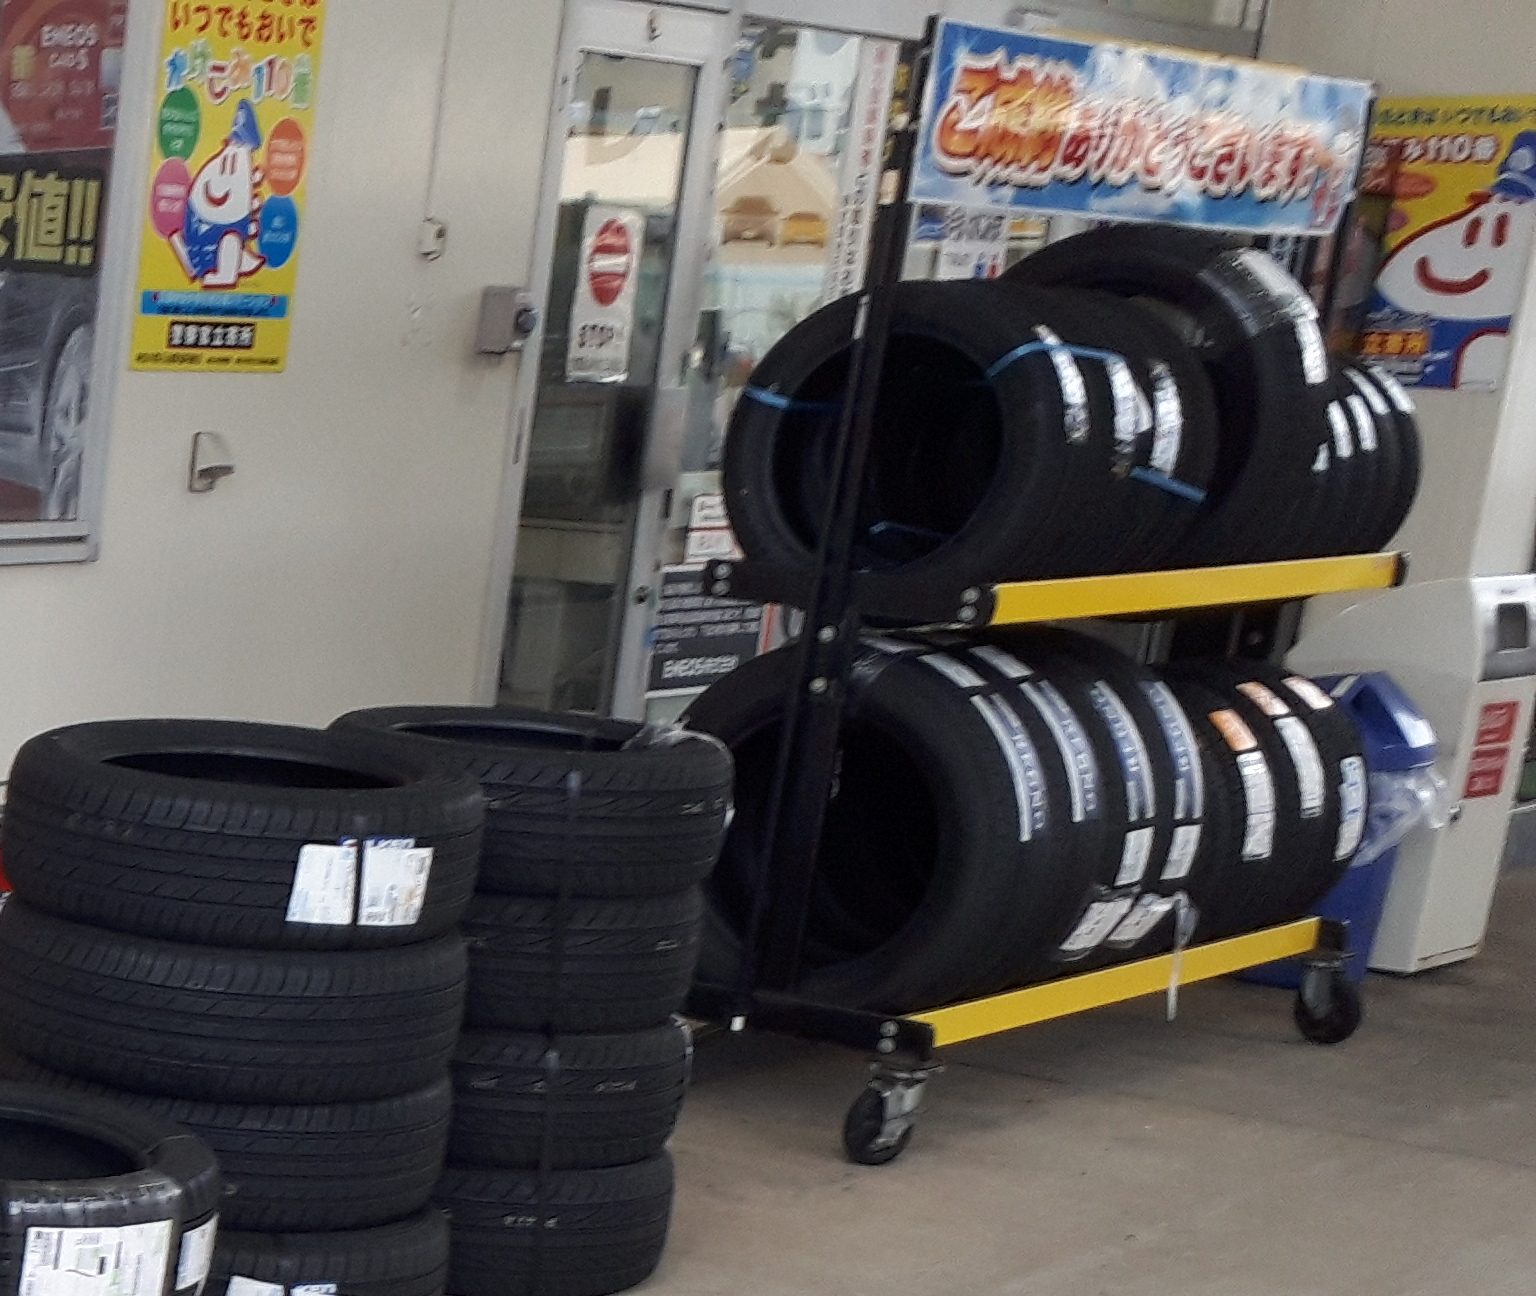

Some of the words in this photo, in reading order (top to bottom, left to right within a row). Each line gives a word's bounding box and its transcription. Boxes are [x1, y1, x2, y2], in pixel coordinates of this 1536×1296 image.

[168, 3, 318, 48] いつでもおいで
